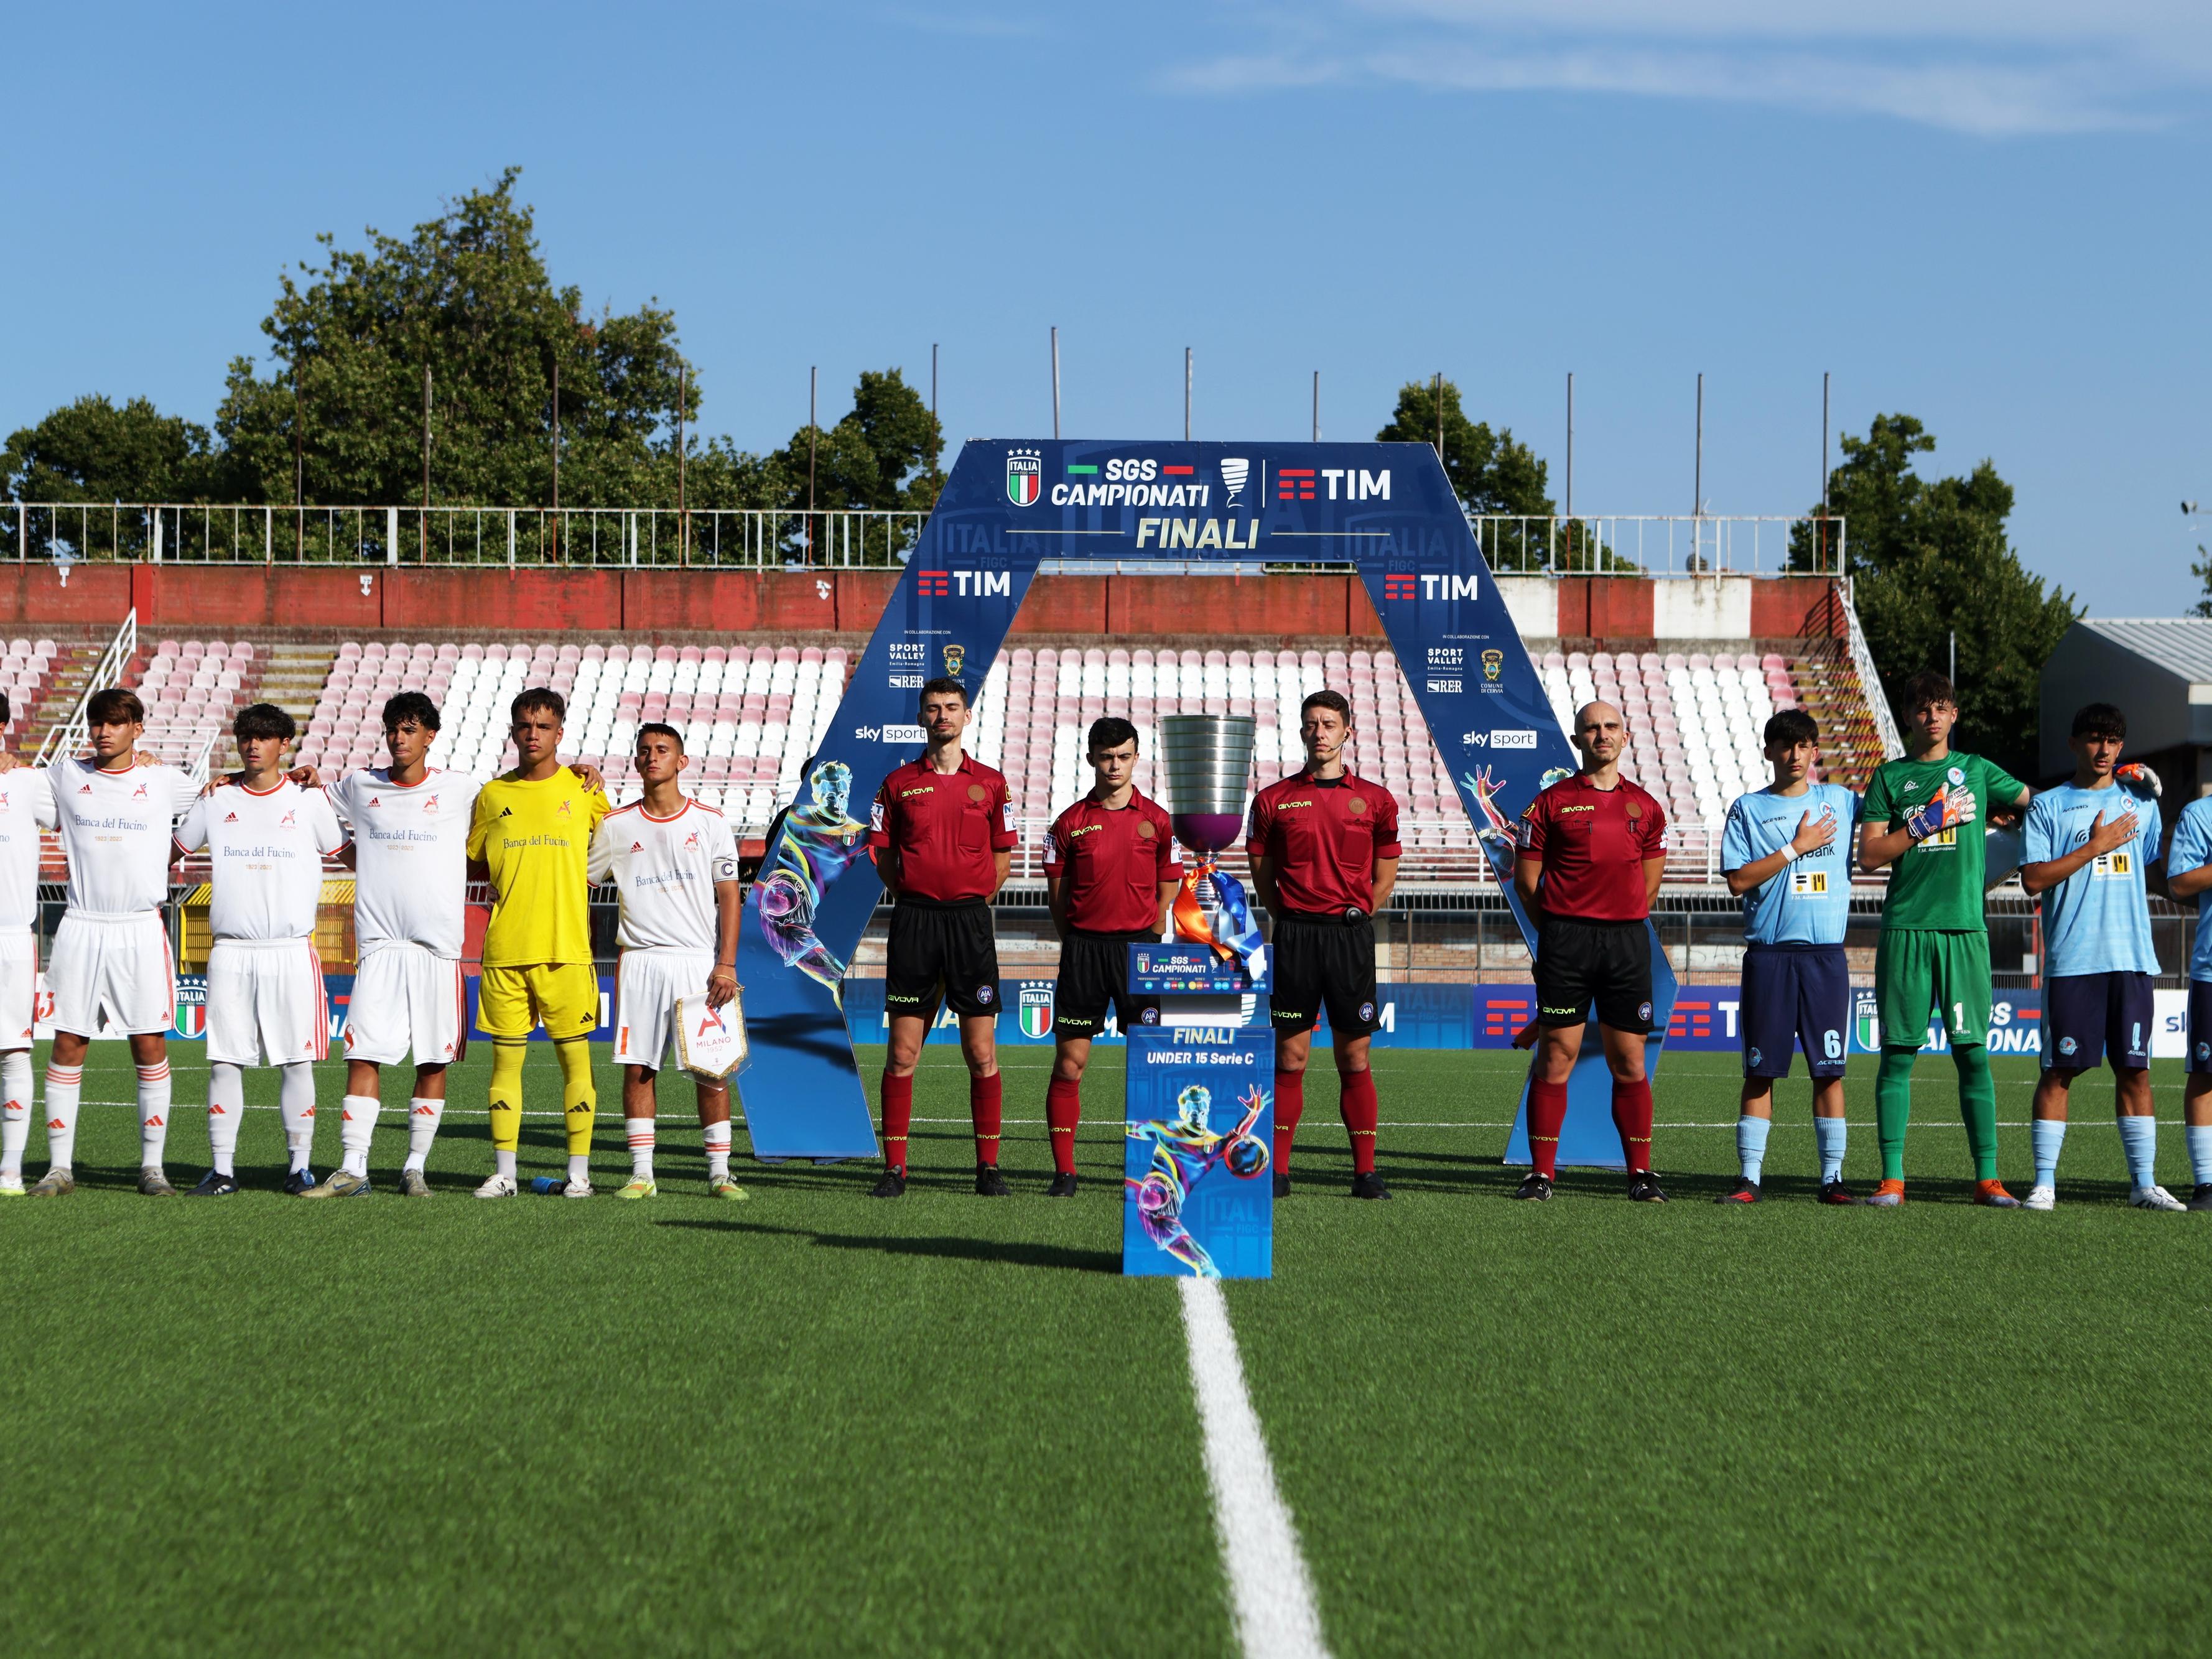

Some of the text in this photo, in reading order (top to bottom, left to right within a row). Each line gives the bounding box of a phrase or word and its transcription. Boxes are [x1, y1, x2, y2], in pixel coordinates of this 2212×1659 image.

[1010, 461, 1038, 471] ITALIA
[1105, 458, 1157, 481] SGS
[1321, 470, 1390, 500] TIM
[1051, 483, 1209, 507] CAMPIONATI
[1136, 518, 1259, 549] FINALI
[981, 557, 1008, 568] FIGC
[1388, 560, 1415, 571] FIGC
[954, 571, 1010, 597] TIM
[1421, 574, 1478, 600] TIM
[890, 644, 925, 652] SPORT
[1428, 648, 1463, 656] SPORT
[855, 725, 926, 741] sky sport
[1462, 731, 1533, 747] sky sport
[902, 787, 934, 797] GIVOVA
[1278, 801, 1312, 809] GIVOVA
[75, 815, 147, 831] Banca del Fucino
[1762, 816, 1787, 825] ACERBIS
[369, 829, 437, 842] Banca del Fucino
[1071, 825, 1102, 837] GIVOVA
[503, 834, 570, 849] Banca del Fucino
[224, 846, 295, 858] Banca del Fucino
[635, 869, 697, 887] Banca del Fucino
[1171, 956, 1189, 964] SGS
[1152, 965, 1206, 974] CAMPIONATI
[177, 991, 205, 1001] ITALIA
[888, 995, 919, 1003] GIVOVA
[1023, 993, 1050, 1003] ITALIA
[1145, 1012, 1156, 1020] AIA
[1272, 1010, 1302, 1019] GVOVA
[1859, 1005, 1878, 1016] ITAL
[1953, 1002, 1963, 1030] 1
[1058, 1016, 1092, 1026] GIVOVA
[696, 1036, 732, 1048] MILANO
[1173, 1028, 1235, 1044] FINALI
[1824, 1029, 1841, 1058] 6
[1147, 1052, 1192, 1064] UNDER
[1195, 1053, 1207, 1063] 15
[1210, 1053, 1243, 1064] Serie
[1245, 1053, 1254, 1064] C
